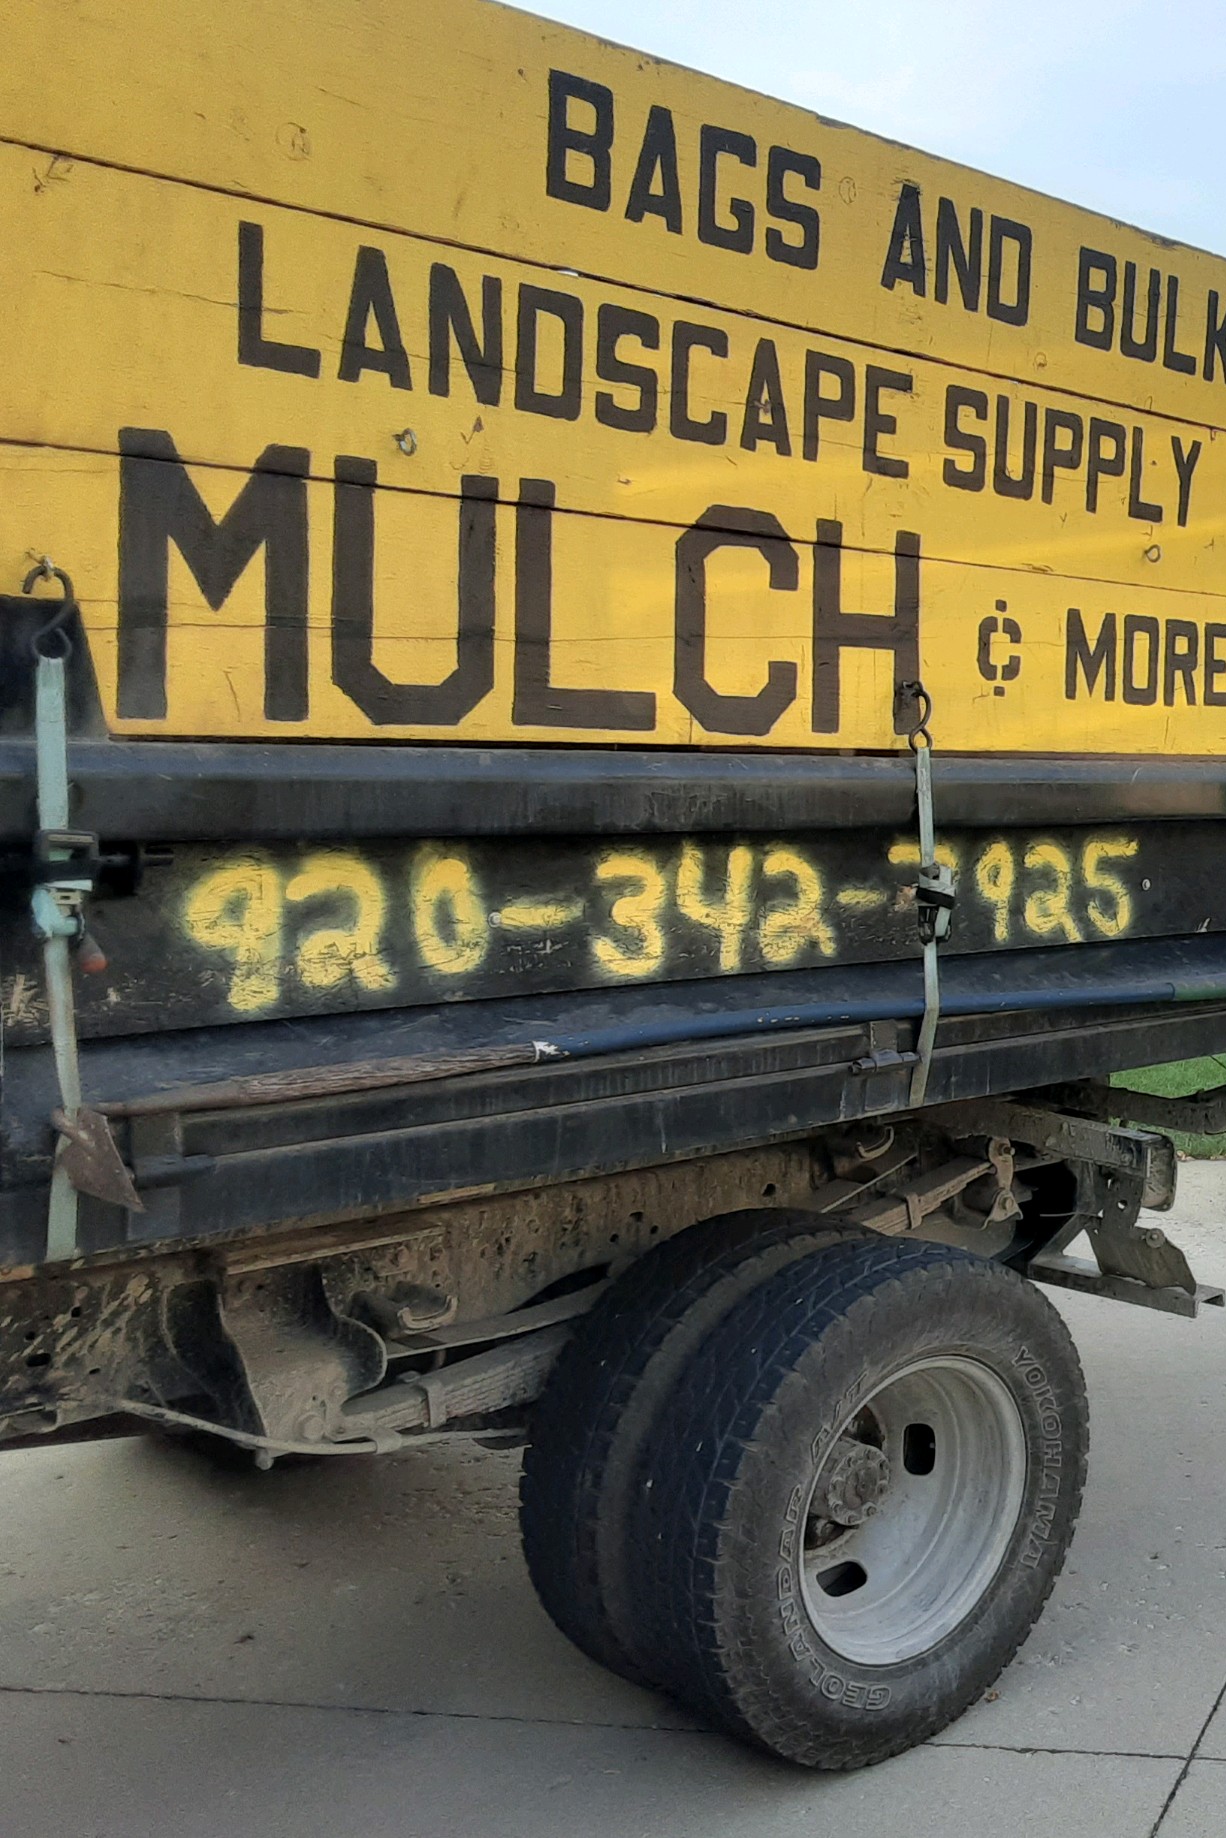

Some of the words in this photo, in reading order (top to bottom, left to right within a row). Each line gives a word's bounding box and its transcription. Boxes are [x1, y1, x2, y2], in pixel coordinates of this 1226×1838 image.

[547, 69, 821, 270] BAGS
[881, 183, 1032, 327] AND
[238, 221, 914, 480] LANDSCAPE
[943, 384, 1202, 528] SUPPLY
[117, 427, 921, 736] MULCH
[1012, 1346, 1062, 1569] YOKOHAMA
[777, 1484, 892, 1711] GEOLANDAR
